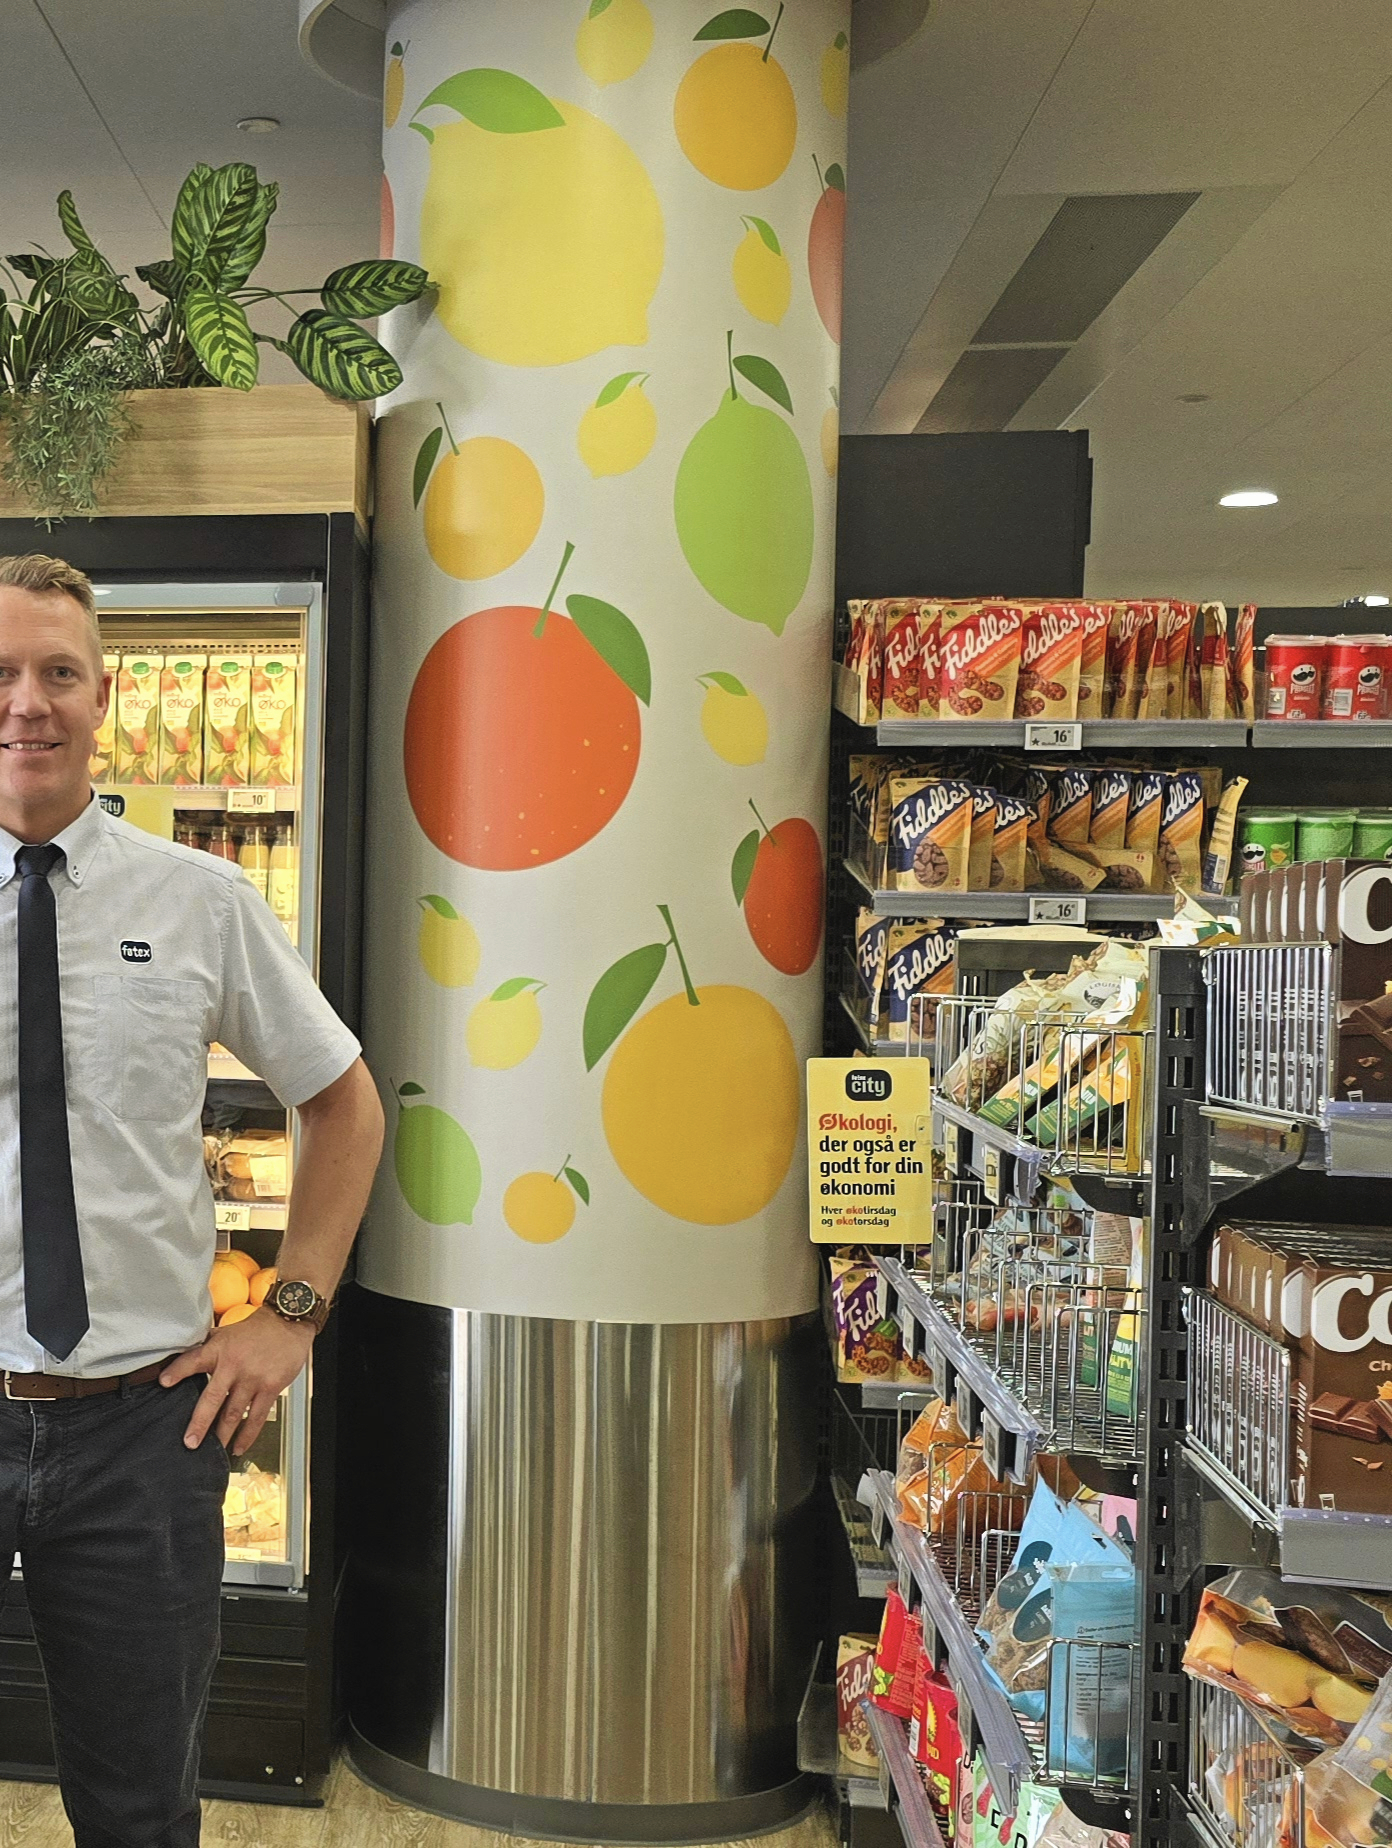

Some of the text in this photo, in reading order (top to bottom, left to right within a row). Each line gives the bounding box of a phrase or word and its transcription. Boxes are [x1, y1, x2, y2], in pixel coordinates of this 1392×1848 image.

[940, 609, 1021, 680] Fiddle's
[893, 781, 971, 850] Fiddle's
[851, 1076, 886, 1097] city
[819, 1113, 898, 1134] Økologi,
[819, 1134, 916, 1156] der også er
[820, 1156, 923, 1177] godt for din
[820, 1178, 896, 1196] økonomi
[821, 1205, 897, 1217] Hver økotirsdag
[821, 1216, 890, 1228] og økotorsdag
